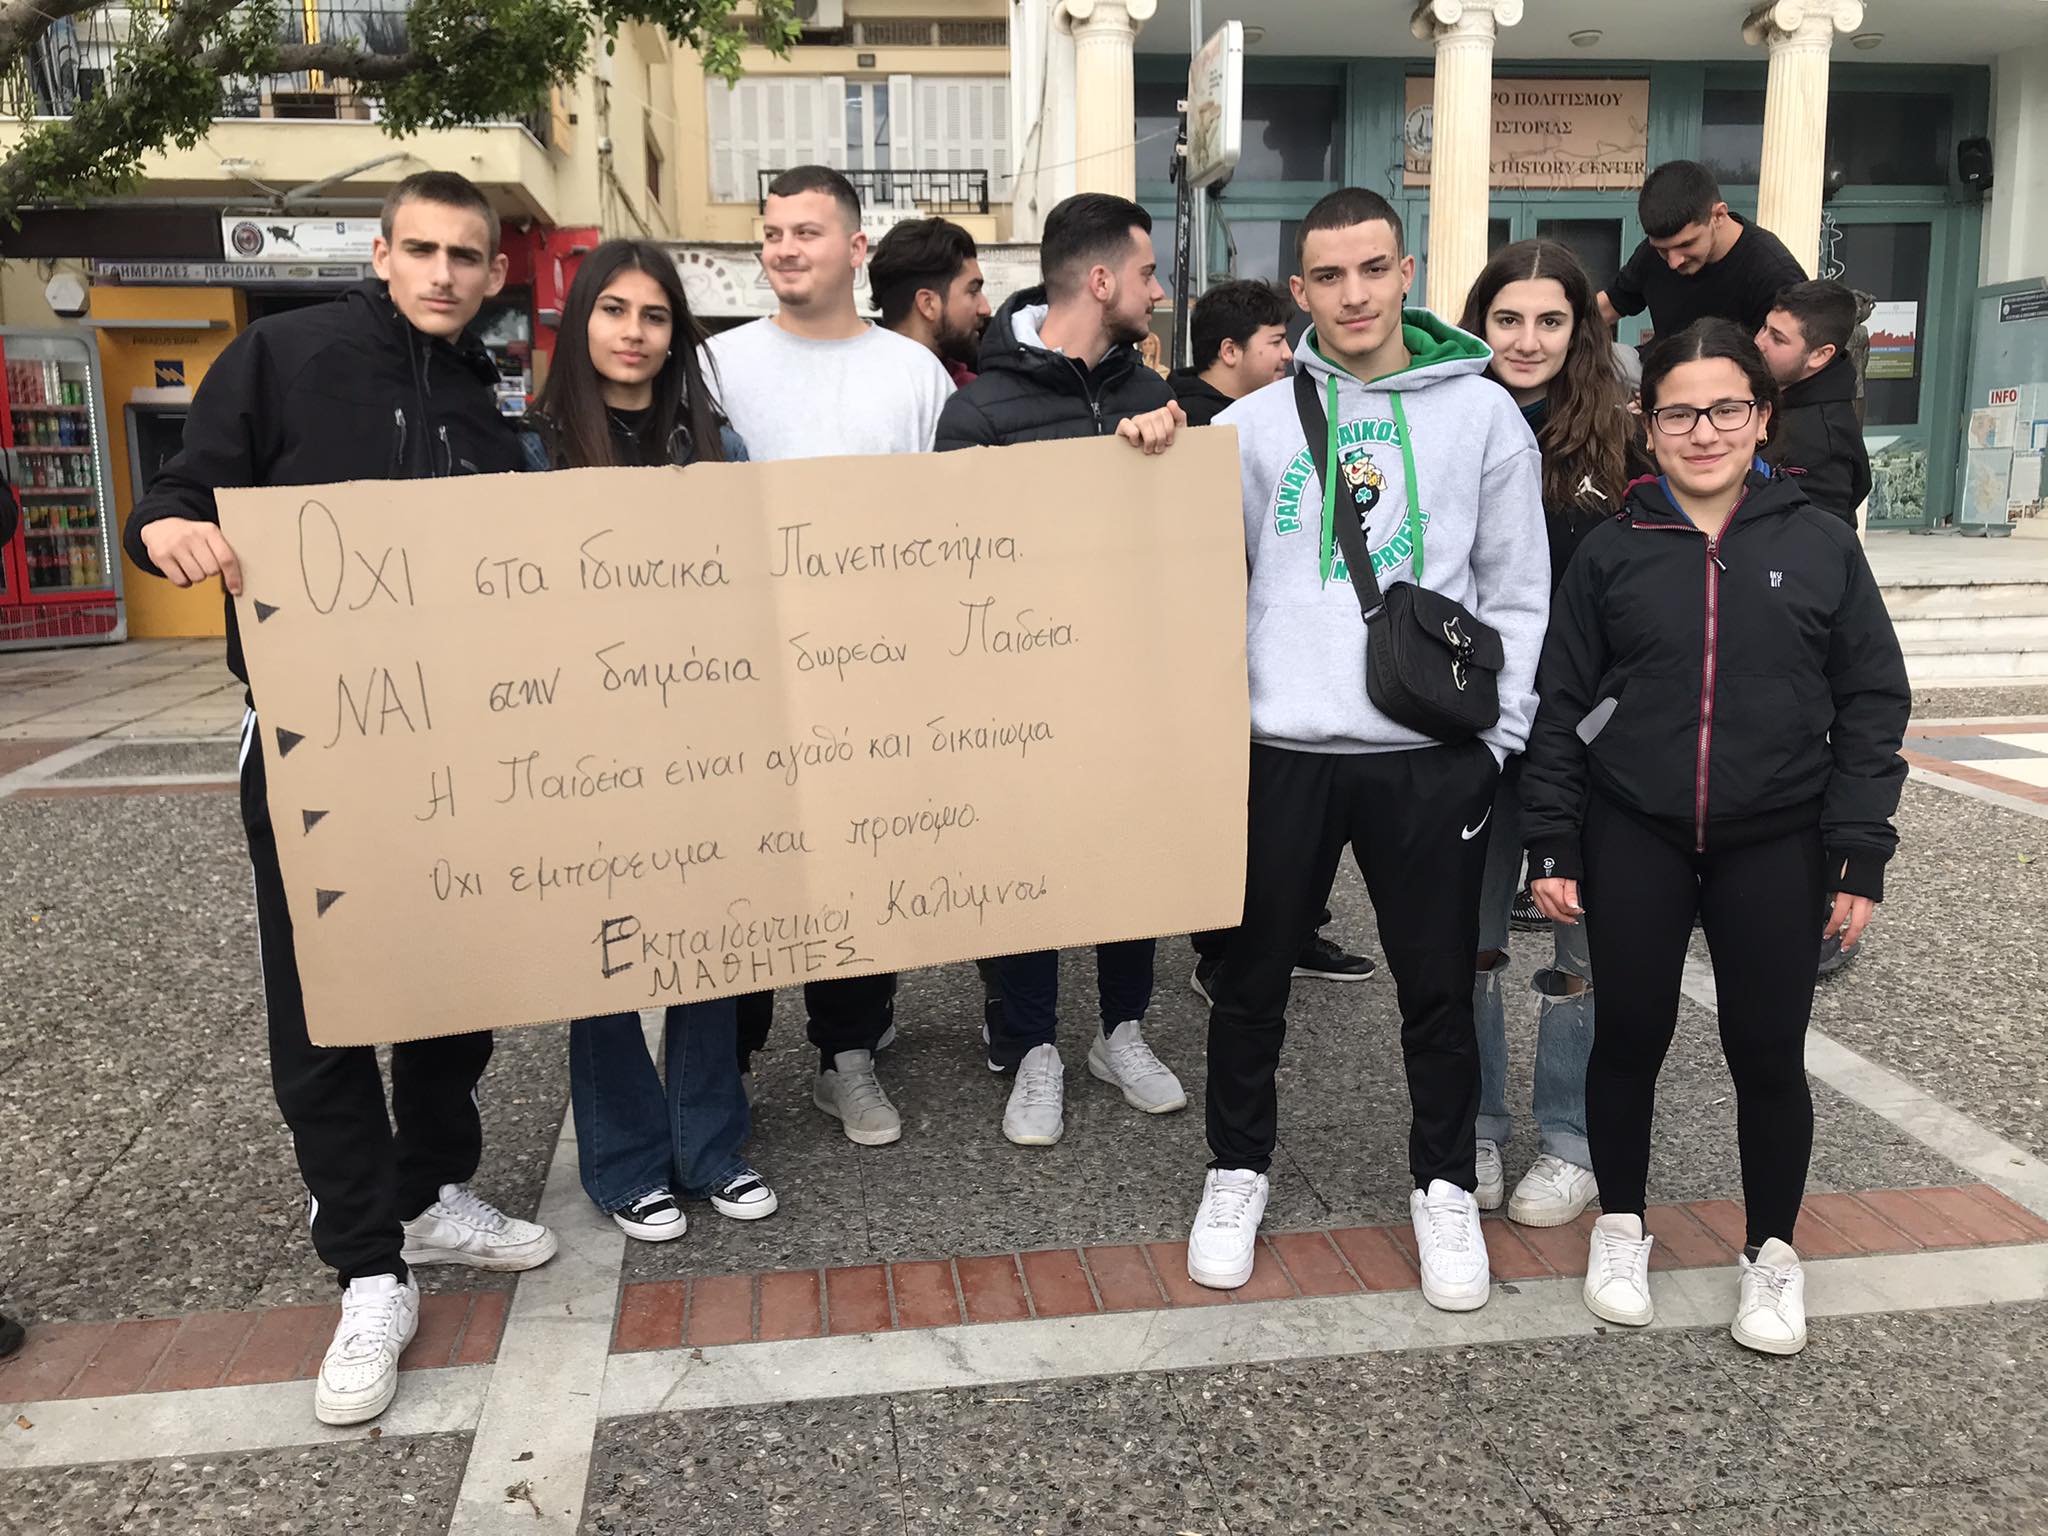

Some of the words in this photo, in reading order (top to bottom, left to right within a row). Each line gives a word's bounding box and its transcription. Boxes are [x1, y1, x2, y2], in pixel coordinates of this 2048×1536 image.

[1514, 92, 1623, 106] ΠΟΛΙΤΙΣΜΟΥ
[1501, 160, 1576, 174] HISTORY
[1579, 160, 1645, 175] CENTER
[1991, 389, 2017, 404] INFO
[595, 641, 760, 708] δημόσια
[789, 632, 906, 682] δωρεάν
[416, 766, 454, 821] Η
[496, 751, 643, 803] Παιδεία
[666, 746, 743, 785] είναι
[767, 726, 853, 786] αγαθό
[869, 734, 910, 758] και
[927, 716, 1054, 758] δικαίωμα
[758, 832, 811, 854] και
